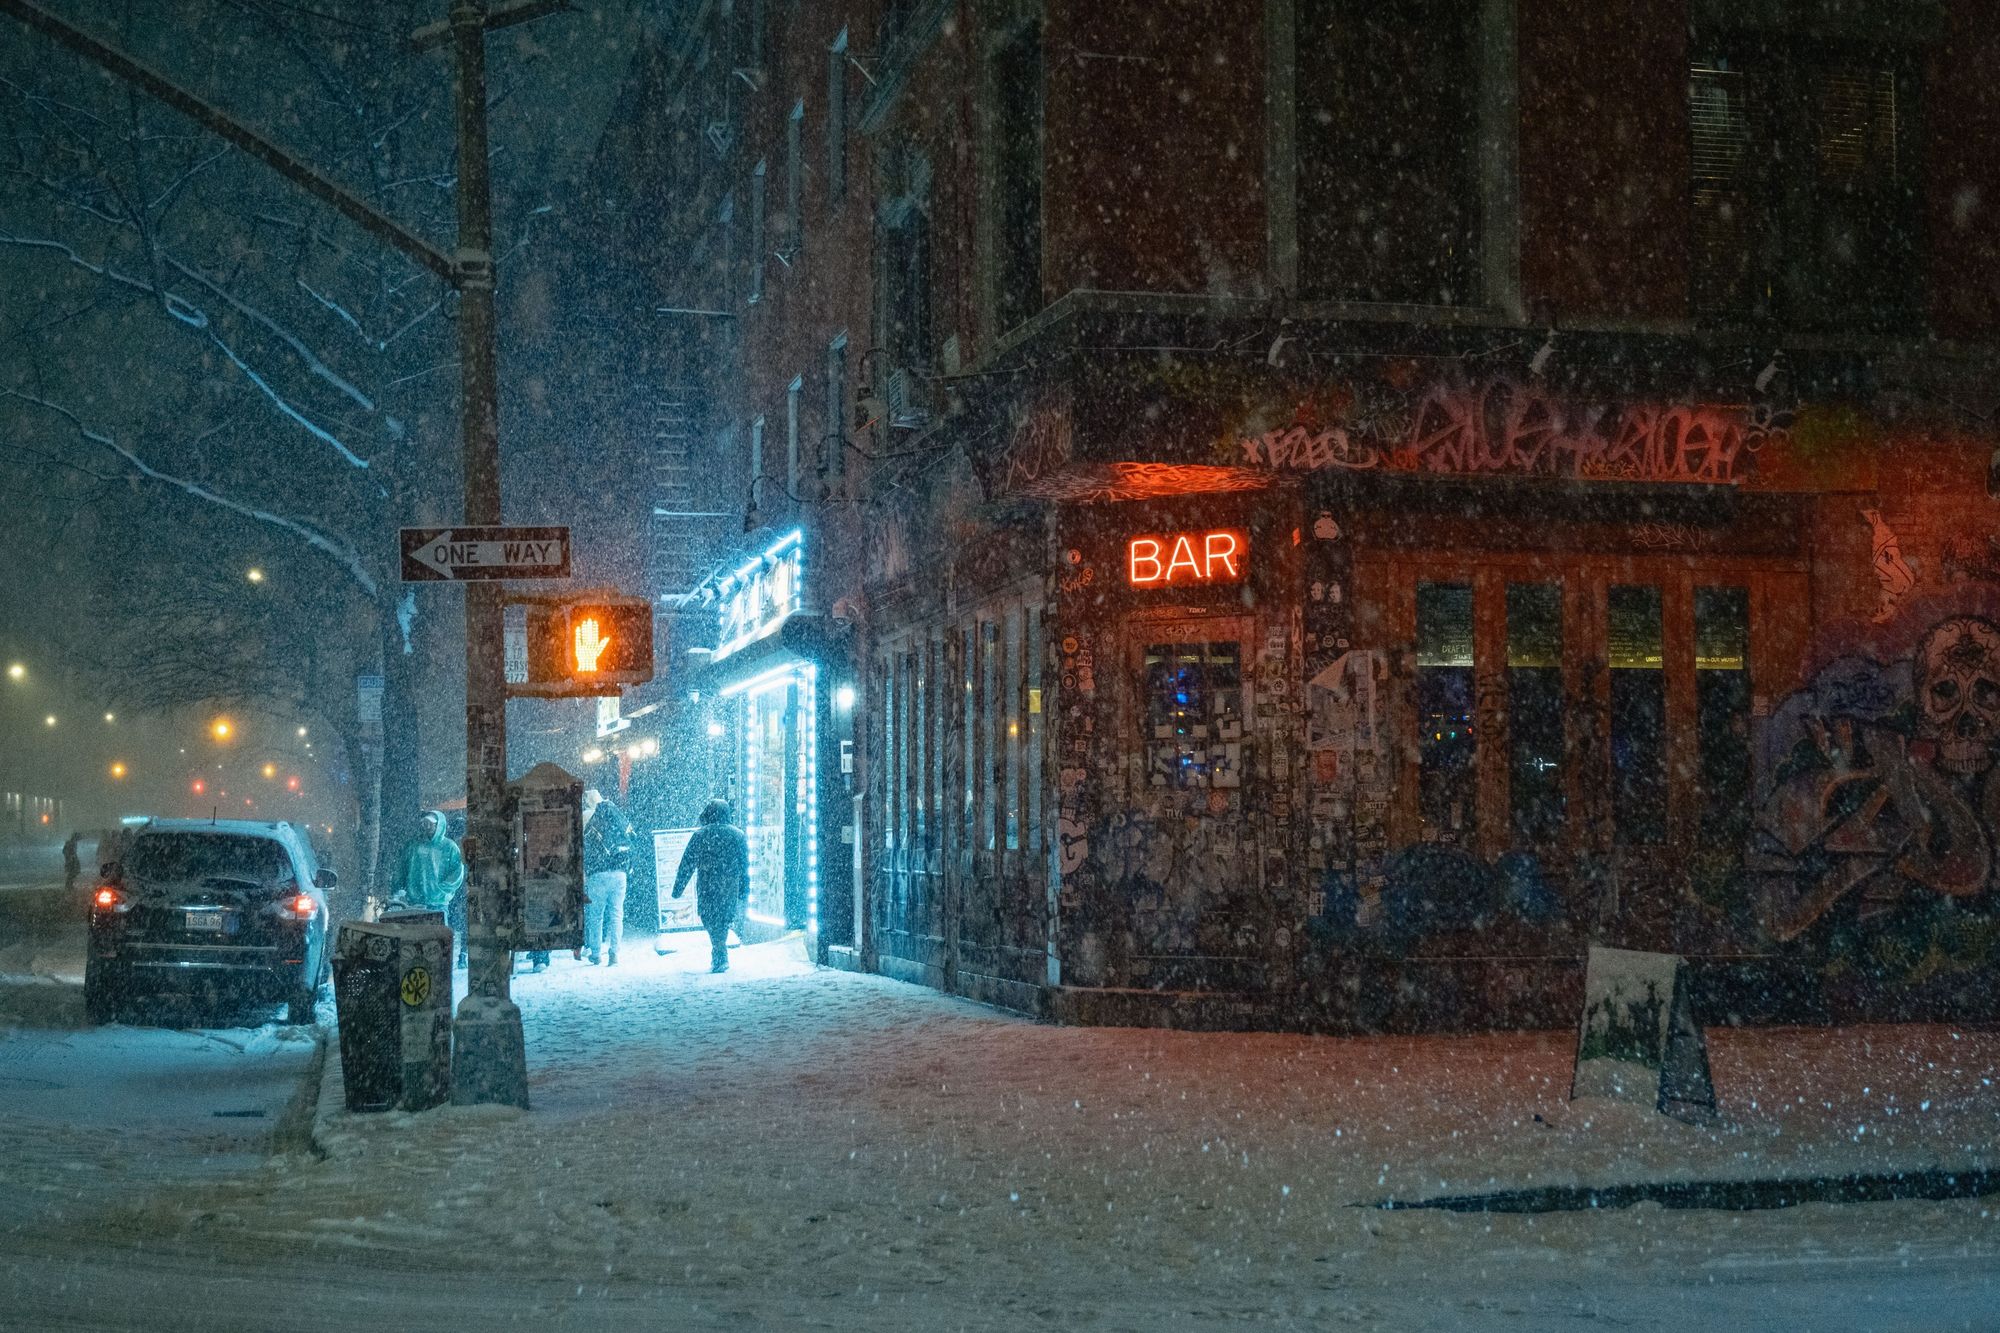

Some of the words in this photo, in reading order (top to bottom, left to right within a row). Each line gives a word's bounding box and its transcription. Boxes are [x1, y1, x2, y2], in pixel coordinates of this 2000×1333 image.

[434, 544, 480, 564] ONE
[503, 542, 552, 563] WAY
[1130, 532, 1239, 585] BAR
